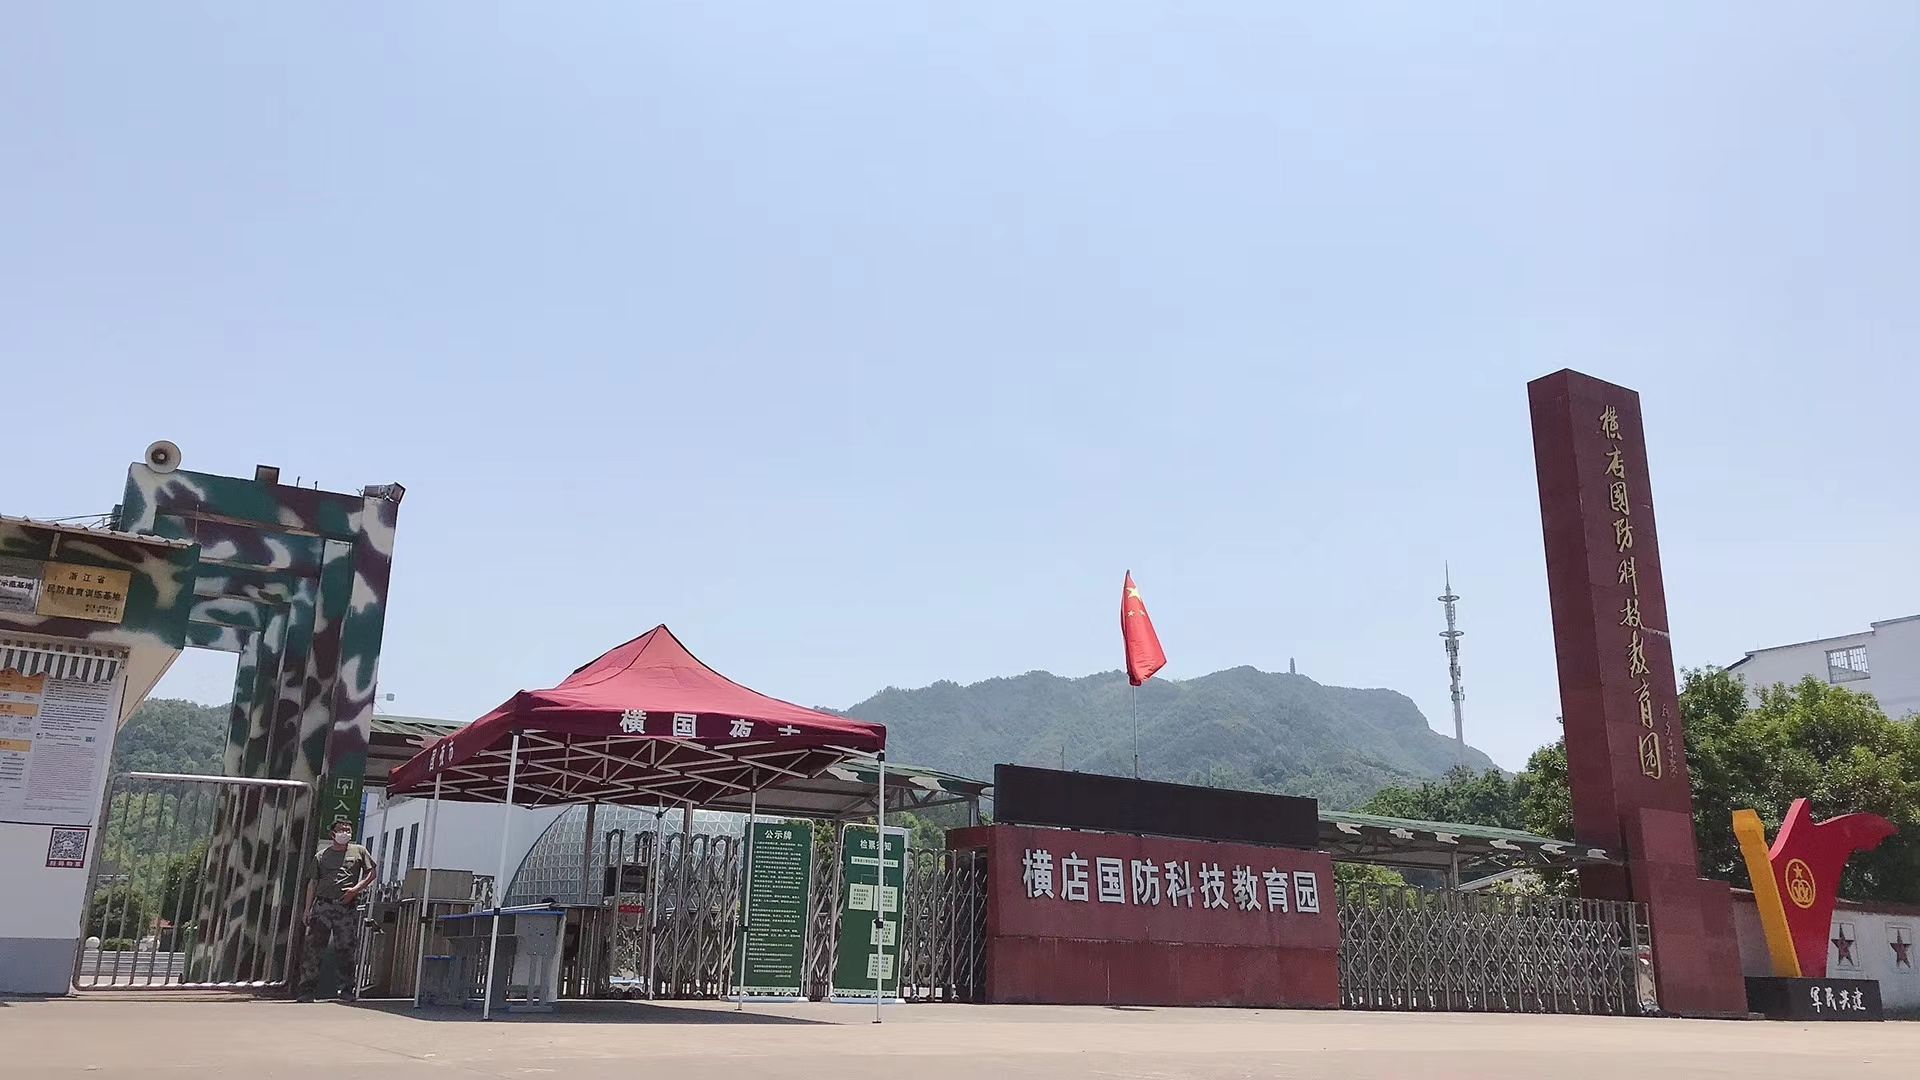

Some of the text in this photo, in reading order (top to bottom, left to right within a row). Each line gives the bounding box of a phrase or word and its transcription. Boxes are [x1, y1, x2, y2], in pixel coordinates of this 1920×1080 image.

[68, 571, 106, 584] 浙江省
[47, 583, 122, 601] 民防教育训练基地
[764, 829, 793, 840] 公示牌
[1022, 849, 1320, 914] 横店国防科技教育园
[1810, 986, 1866, 1013] 军民共建
